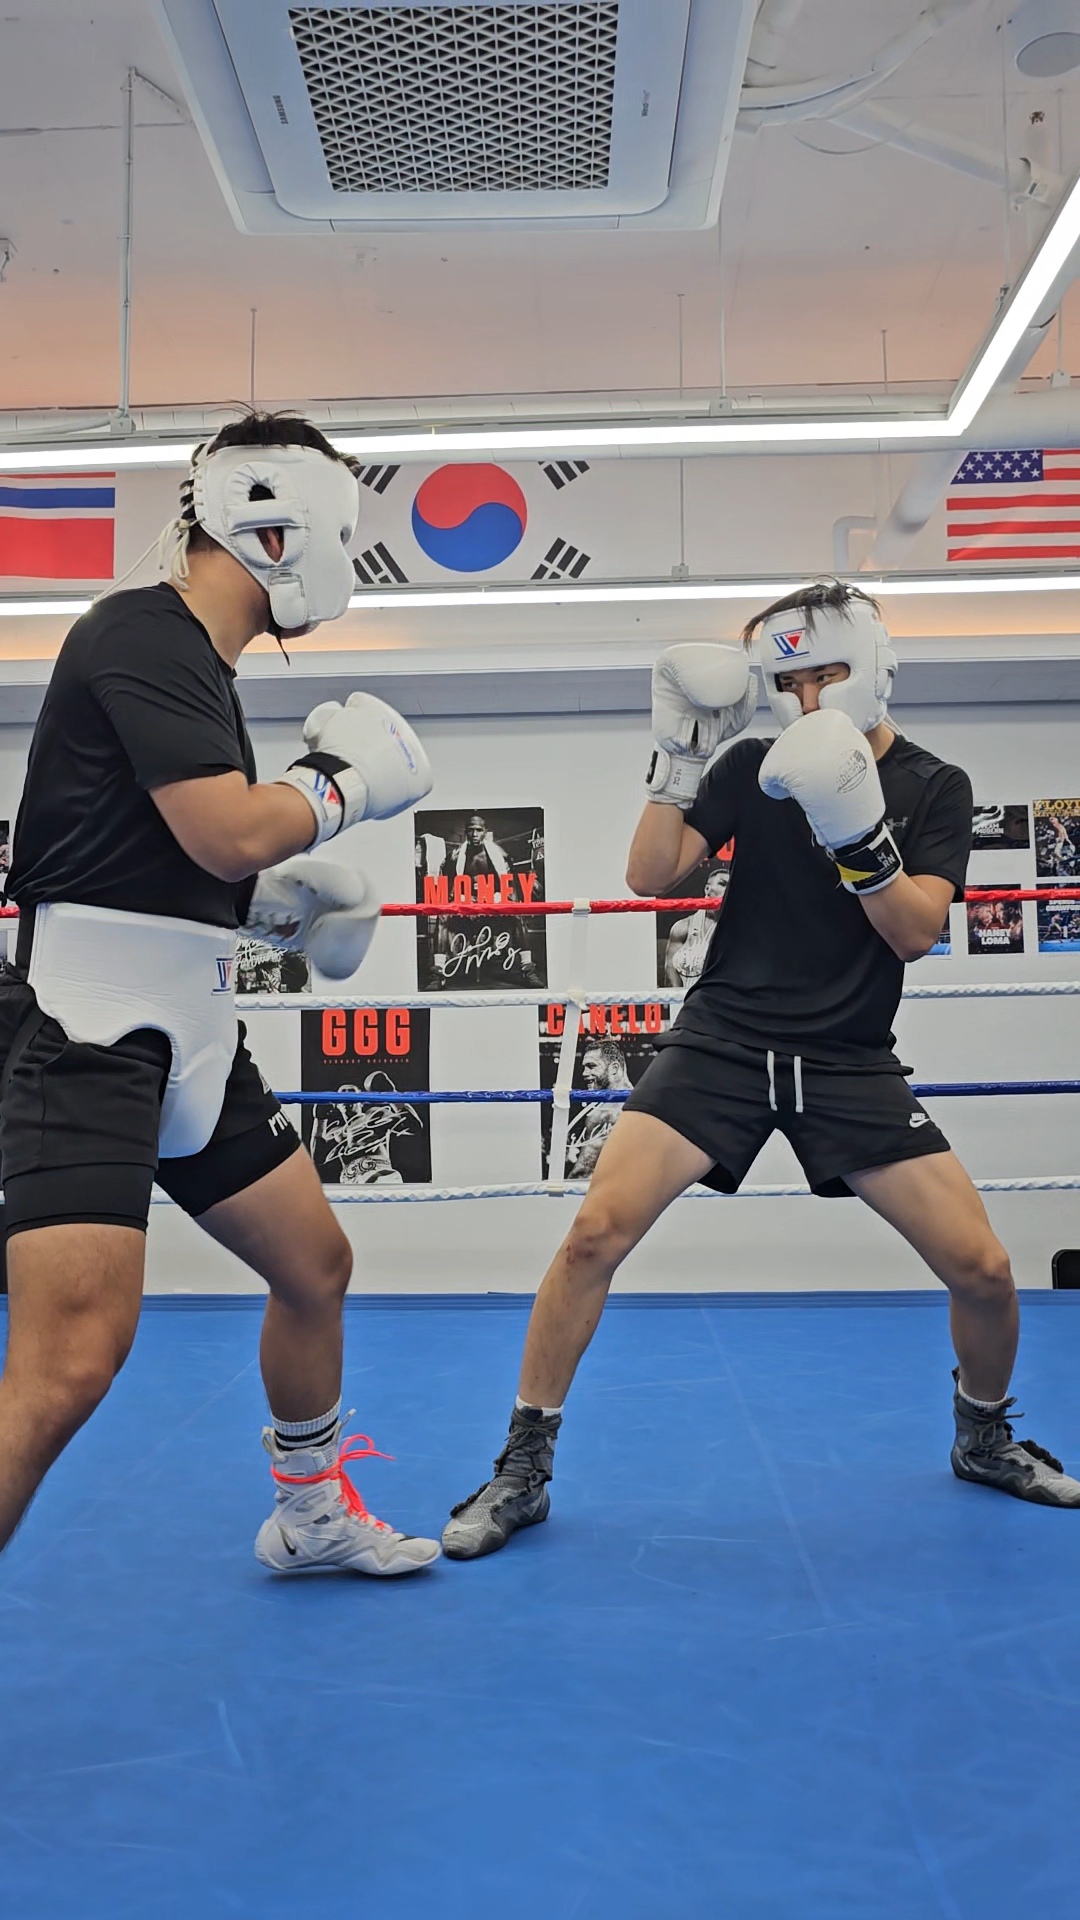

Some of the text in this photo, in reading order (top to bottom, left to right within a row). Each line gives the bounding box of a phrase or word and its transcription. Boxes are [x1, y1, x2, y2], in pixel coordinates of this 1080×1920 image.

[424, 873, 537, 904] MONEY
[979, 929, 1011, 937] HANEY
[981, 936, 1010, 945] LOMA
[322, 1008, 411, 1056] GGG
[547, 1003, 662, 1035] CNELO
